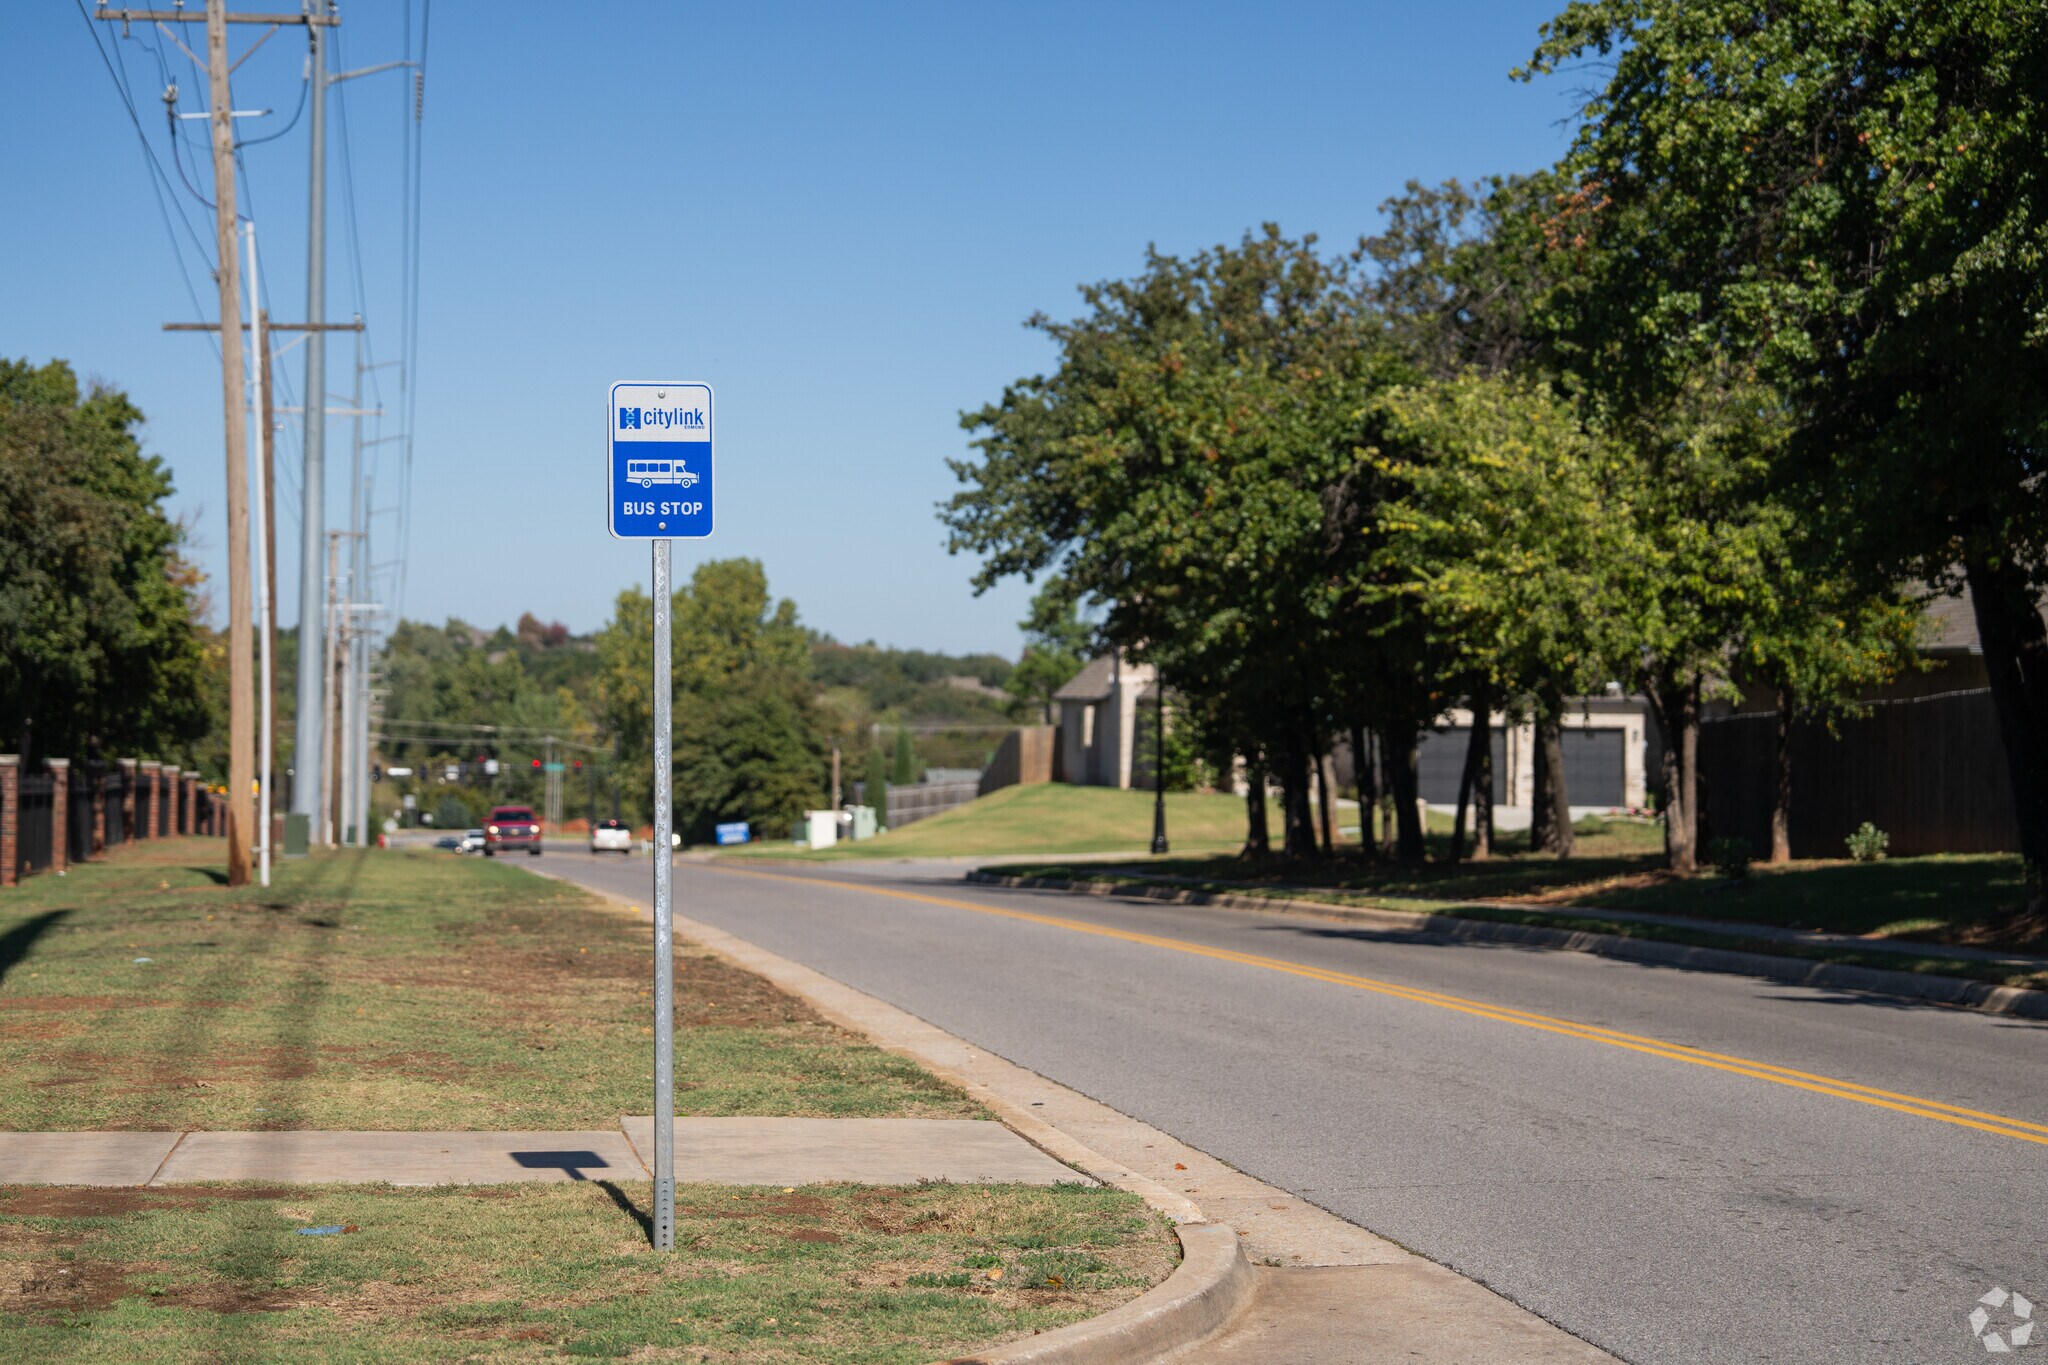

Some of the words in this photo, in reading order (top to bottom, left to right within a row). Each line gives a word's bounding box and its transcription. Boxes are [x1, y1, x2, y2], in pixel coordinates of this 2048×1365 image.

[644, 408, 704, 429] citylink
[623, 501, 655, 515] BUS
[660, 501, 703, 515] STOP
